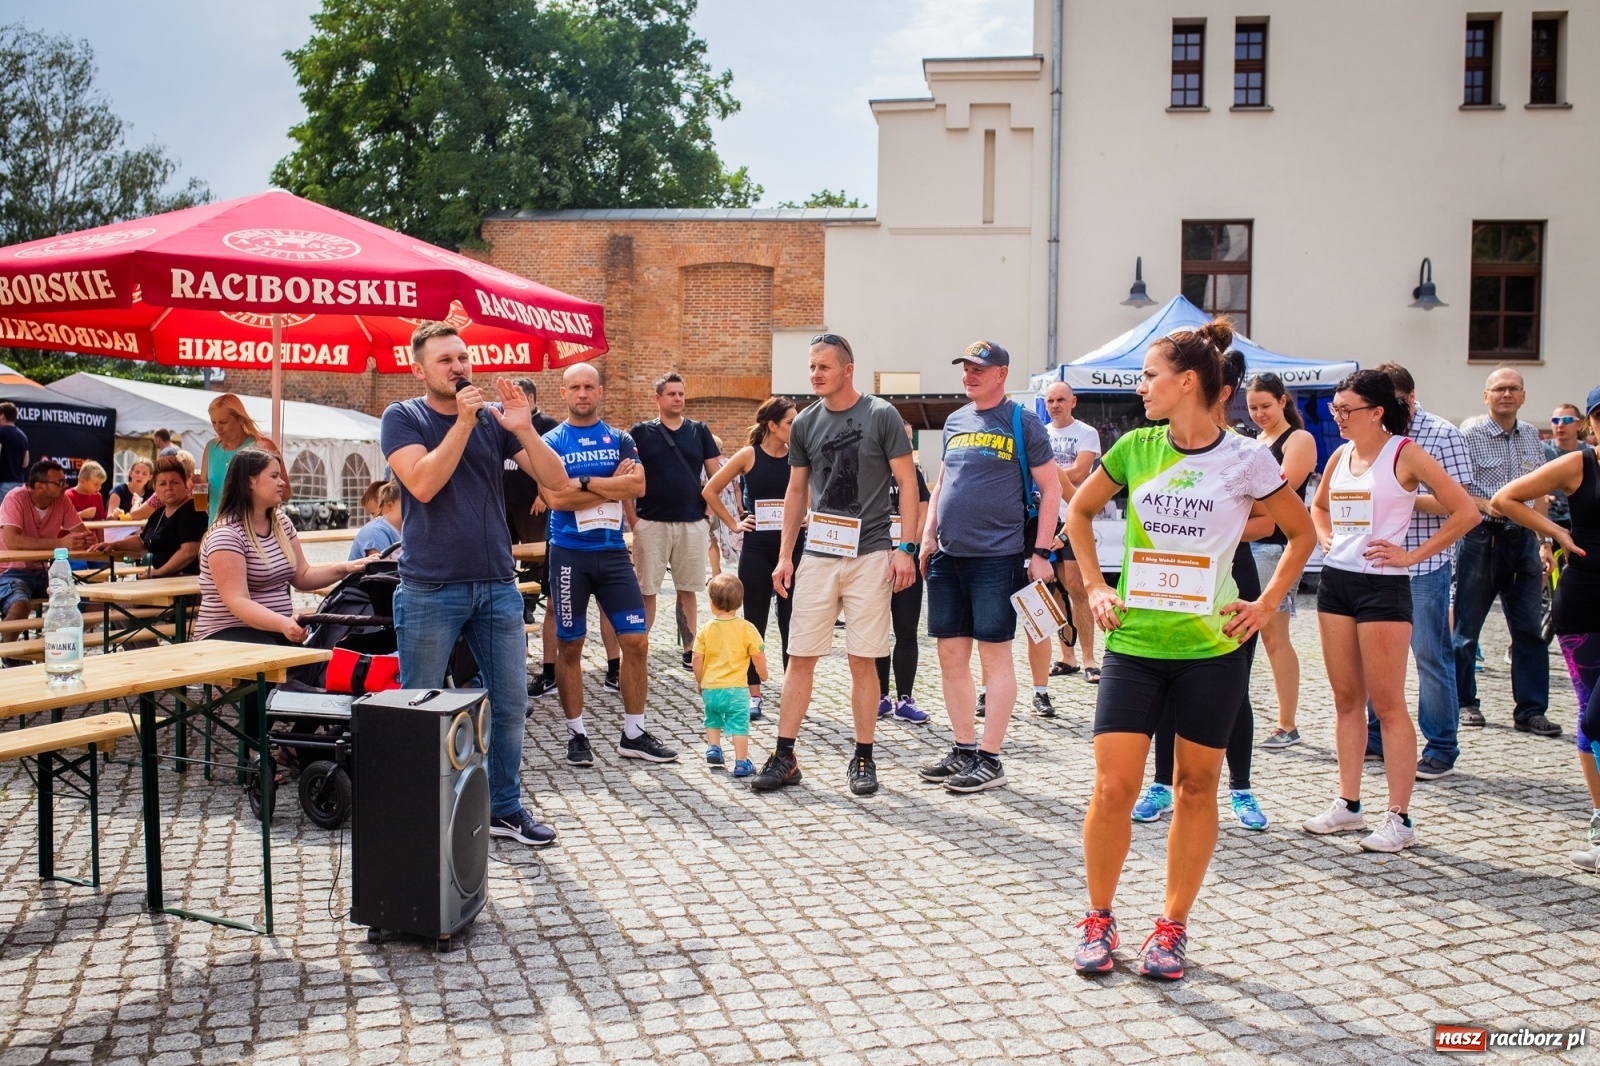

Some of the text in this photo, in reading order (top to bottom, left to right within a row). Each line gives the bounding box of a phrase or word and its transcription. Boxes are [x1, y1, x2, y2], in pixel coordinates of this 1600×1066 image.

[170, 267, 418, 308] RACIBORSKIE
[475, 289, 594, 338] RACIBORSKIE
[1091, 370, 1142, 388] ŚLĄSK
[16, 407, 108, 428] KLEP INTERNETOWY
[51, 456, 84, 470] DIGITE
[597, 506, 604, 516] 6
[1142, 492, 1214, 513] AKTYWNI
[771, 511, 783, 519] 42
[1156, 506, 1198, 519] LYSKI
[1341, 506, 1352, 518] 17
[826, 529, 839, 541] 41
[1143, 520, 1206, 538] GEOFART
[1157, 572, 1180, 588] 30
[560, 565, 574, 628] RUNNERS
